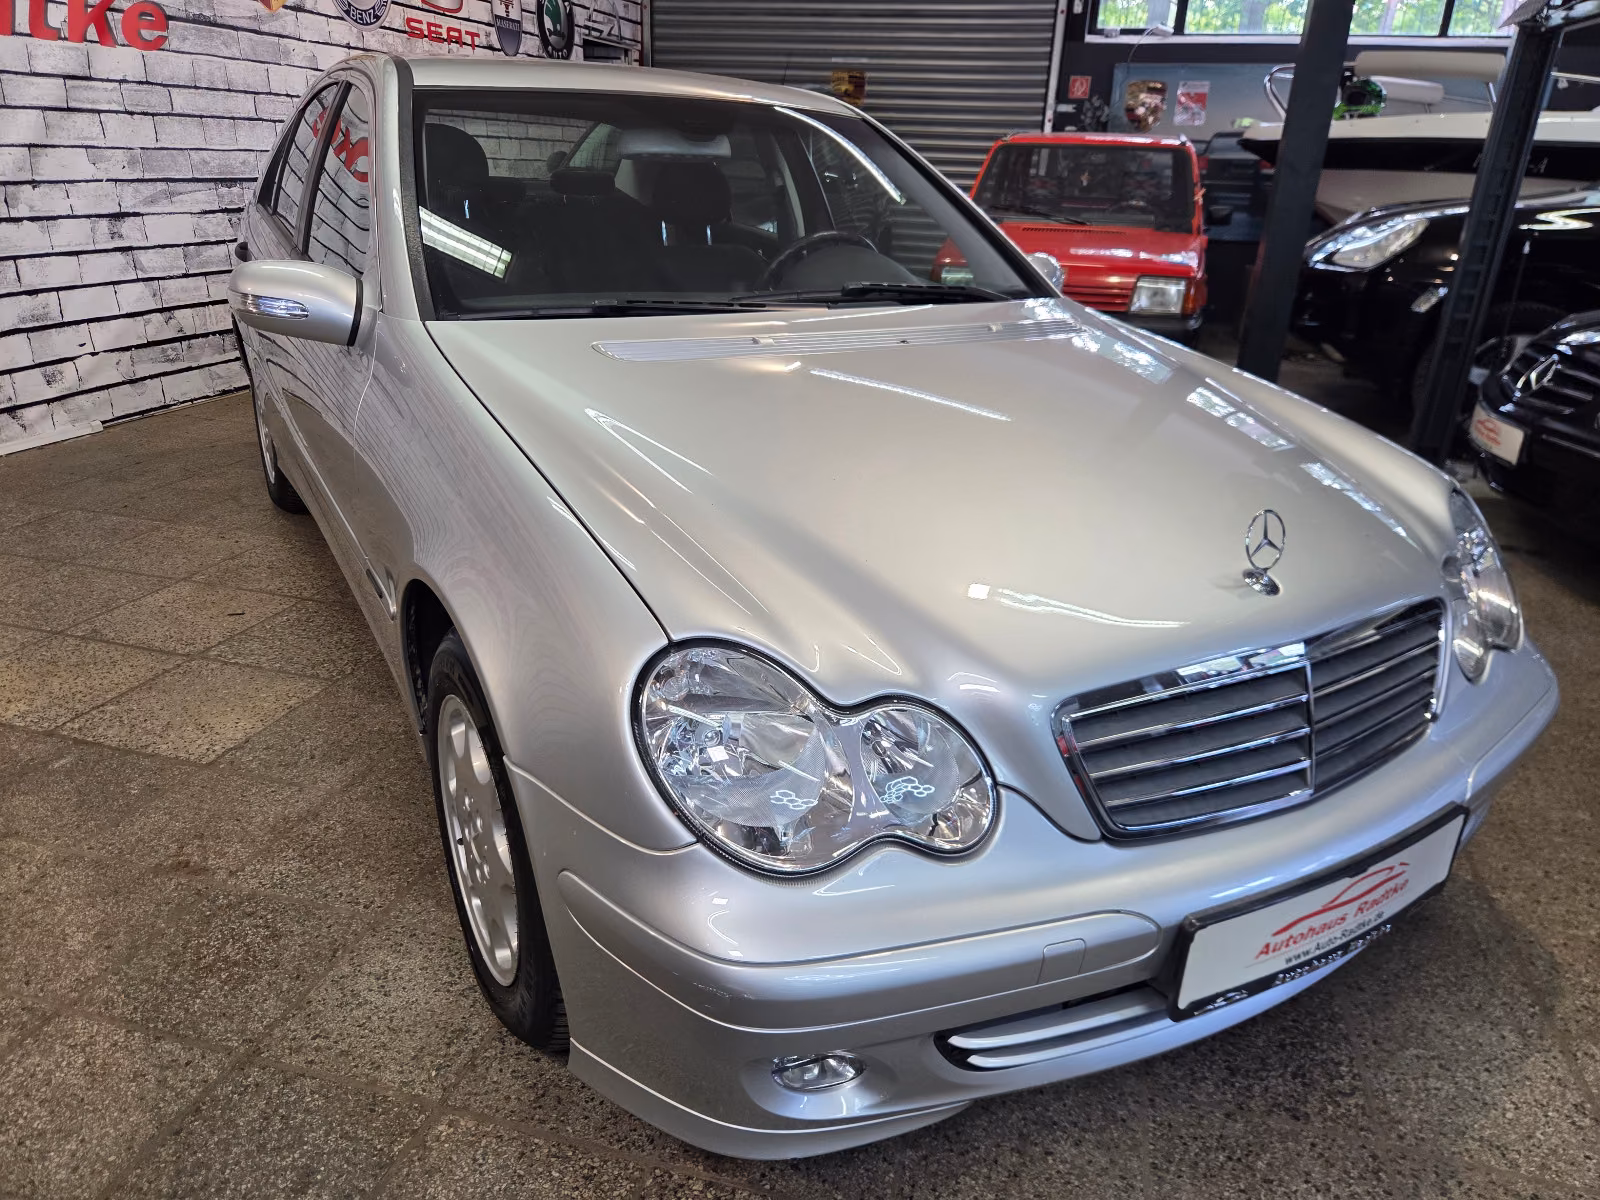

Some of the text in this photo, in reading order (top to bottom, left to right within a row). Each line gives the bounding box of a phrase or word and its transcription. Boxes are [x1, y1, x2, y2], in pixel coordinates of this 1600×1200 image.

[350, 6, 377, 24] BENZ
[496, 18, 520, 32] MASERATI
[405, 17, 481, 51] SEAT
[1254, 913, 1348, 959] Autohaus
[1353, 879, 1409, 917] Radtke
[1285, 911, 1385, 965] www.Auto-Radtke.de
